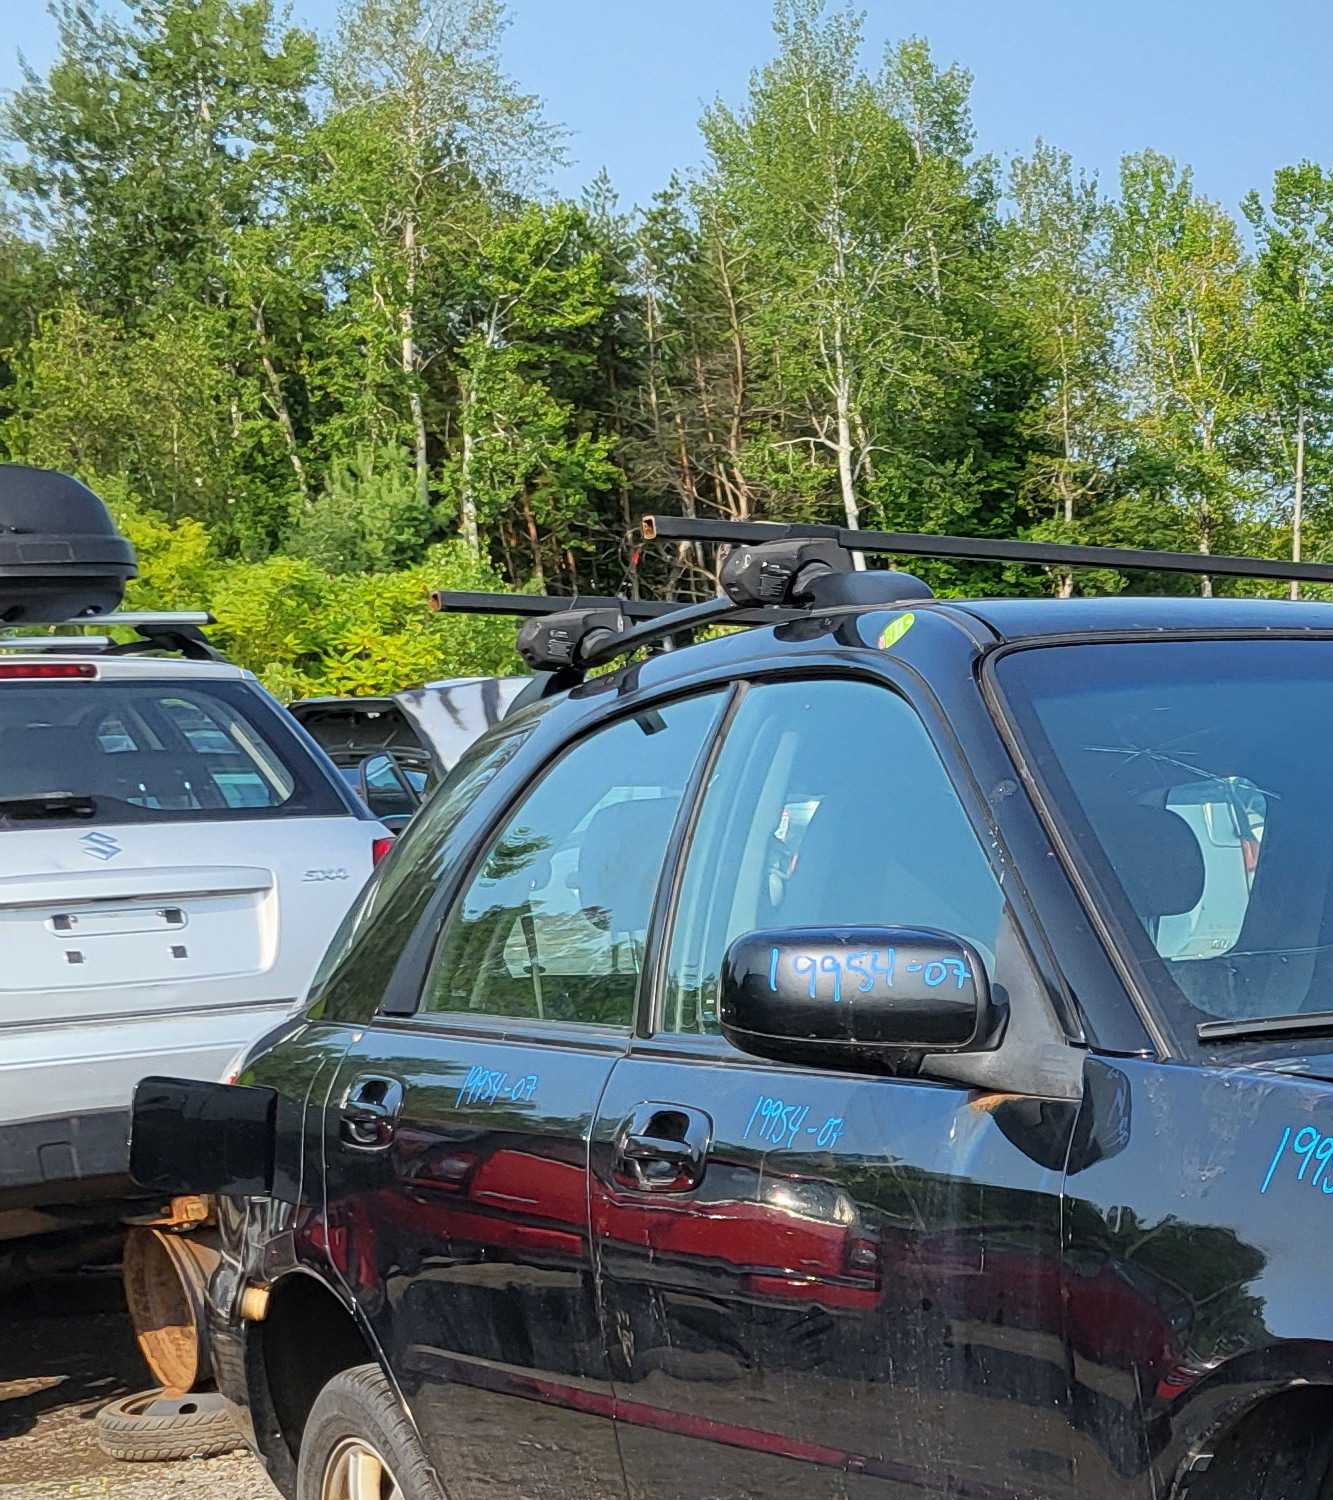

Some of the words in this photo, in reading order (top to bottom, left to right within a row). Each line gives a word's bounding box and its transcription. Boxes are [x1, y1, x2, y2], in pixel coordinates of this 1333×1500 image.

[768, 946, 973, 1002] 19954-07
[455, 1065, 538, 1109] 19954-07
[743, 1095, 844, 1149] 19954-07
